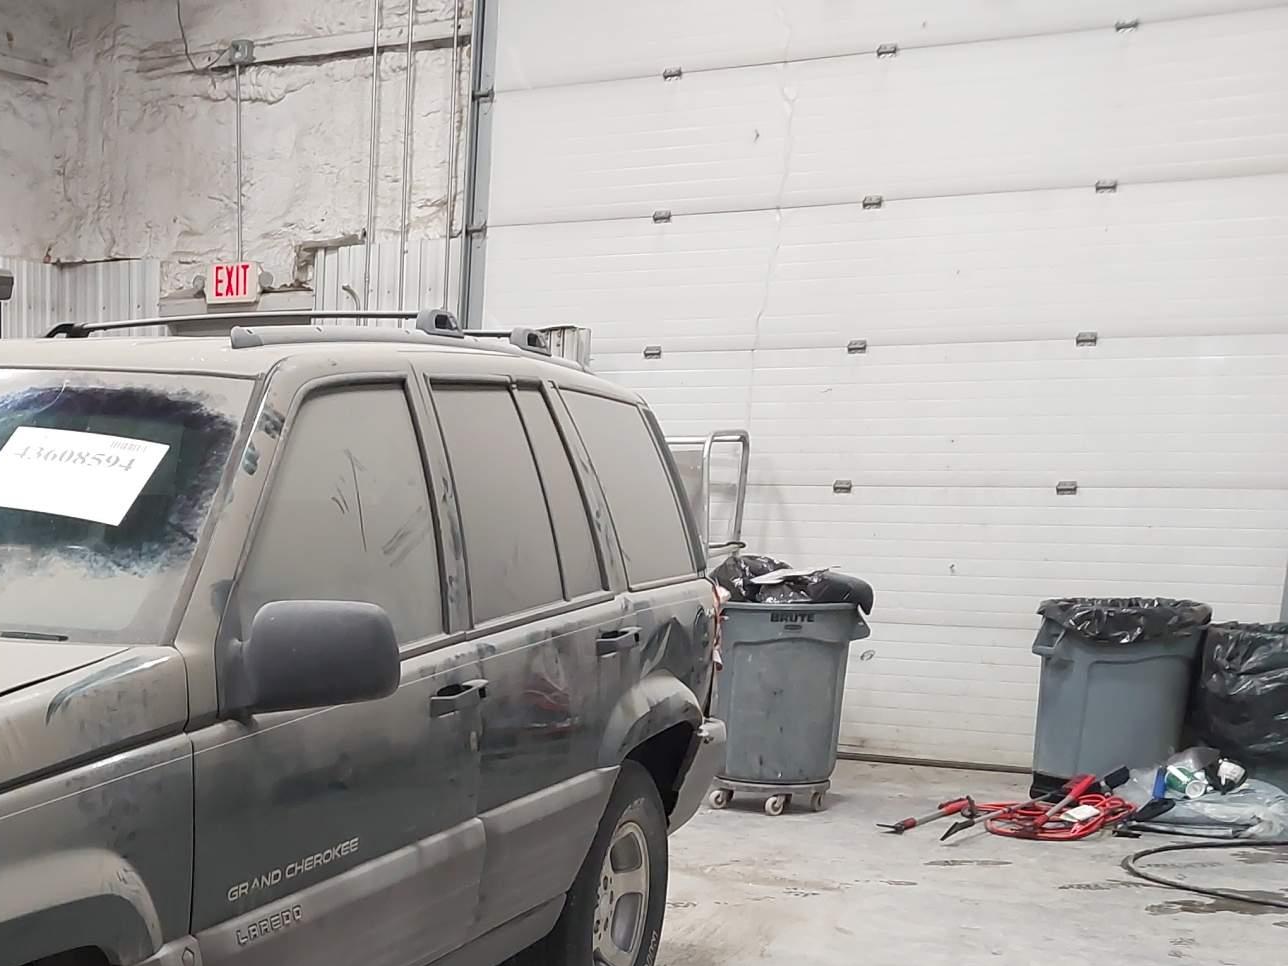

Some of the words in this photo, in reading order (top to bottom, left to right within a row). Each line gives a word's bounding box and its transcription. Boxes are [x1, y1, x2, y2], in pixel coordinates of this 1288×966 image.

[215, 264, 250, 297] EXIT
[14, 444, 136, 472] 43608594
[769, 612, 816, 623] BRUTE
[227, 869, 282, 902] GRAND
[284, 837, 360, 878] CHEROKEE
[235, 904, 303, 947] LAREDO
